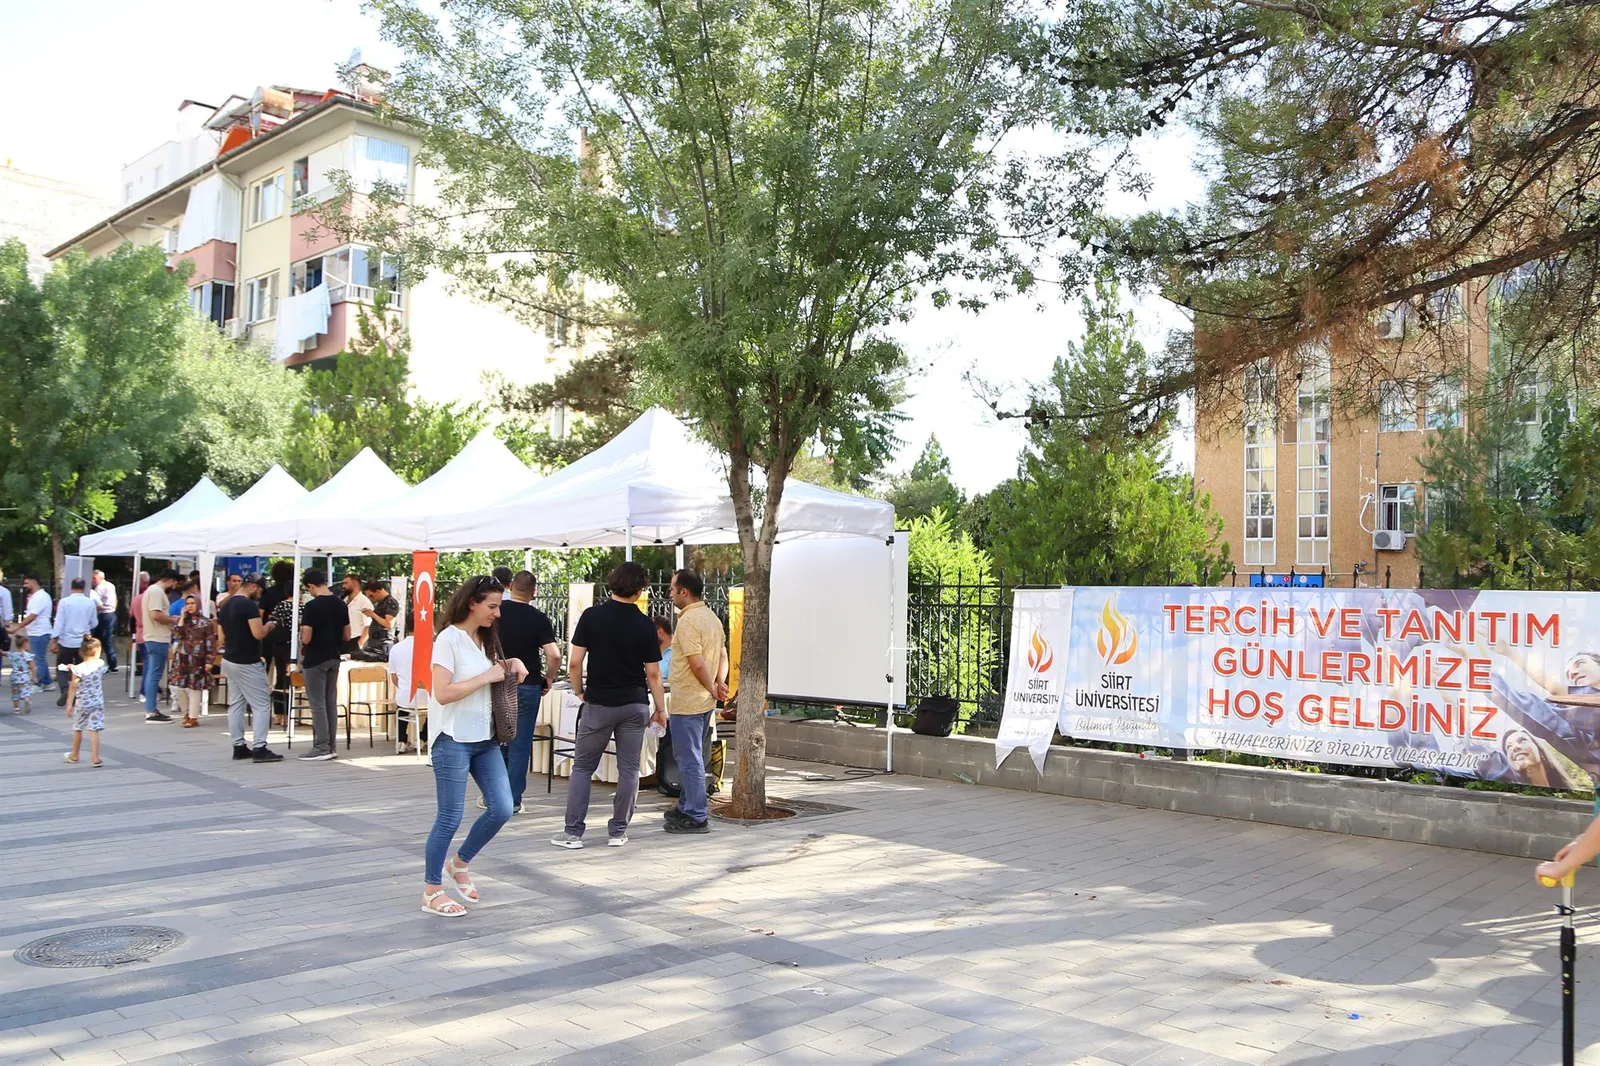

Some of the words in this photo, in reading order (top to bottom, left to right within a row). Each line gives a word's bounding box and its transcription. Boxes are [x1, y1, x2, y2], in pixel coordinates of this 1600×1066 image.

[1163, 600, 1295, 636] TERCİH
[1310, 607, 1362, 638] VE
[1377, 609, 1560, 646] TANITIM
[1101, 671, 1132, 690] SİİRT
[1213, 642, 1492, 691] GÜNLERİMİZE
[1075, 689, 1159, 713] ÜNİVERSİTESİ
[1208, 688, 1285, 726] HOŞ
[1298, 693, 1498, 739] GELDİNİZ
[1326, 739, 1392, 760] BİRLİKTE
